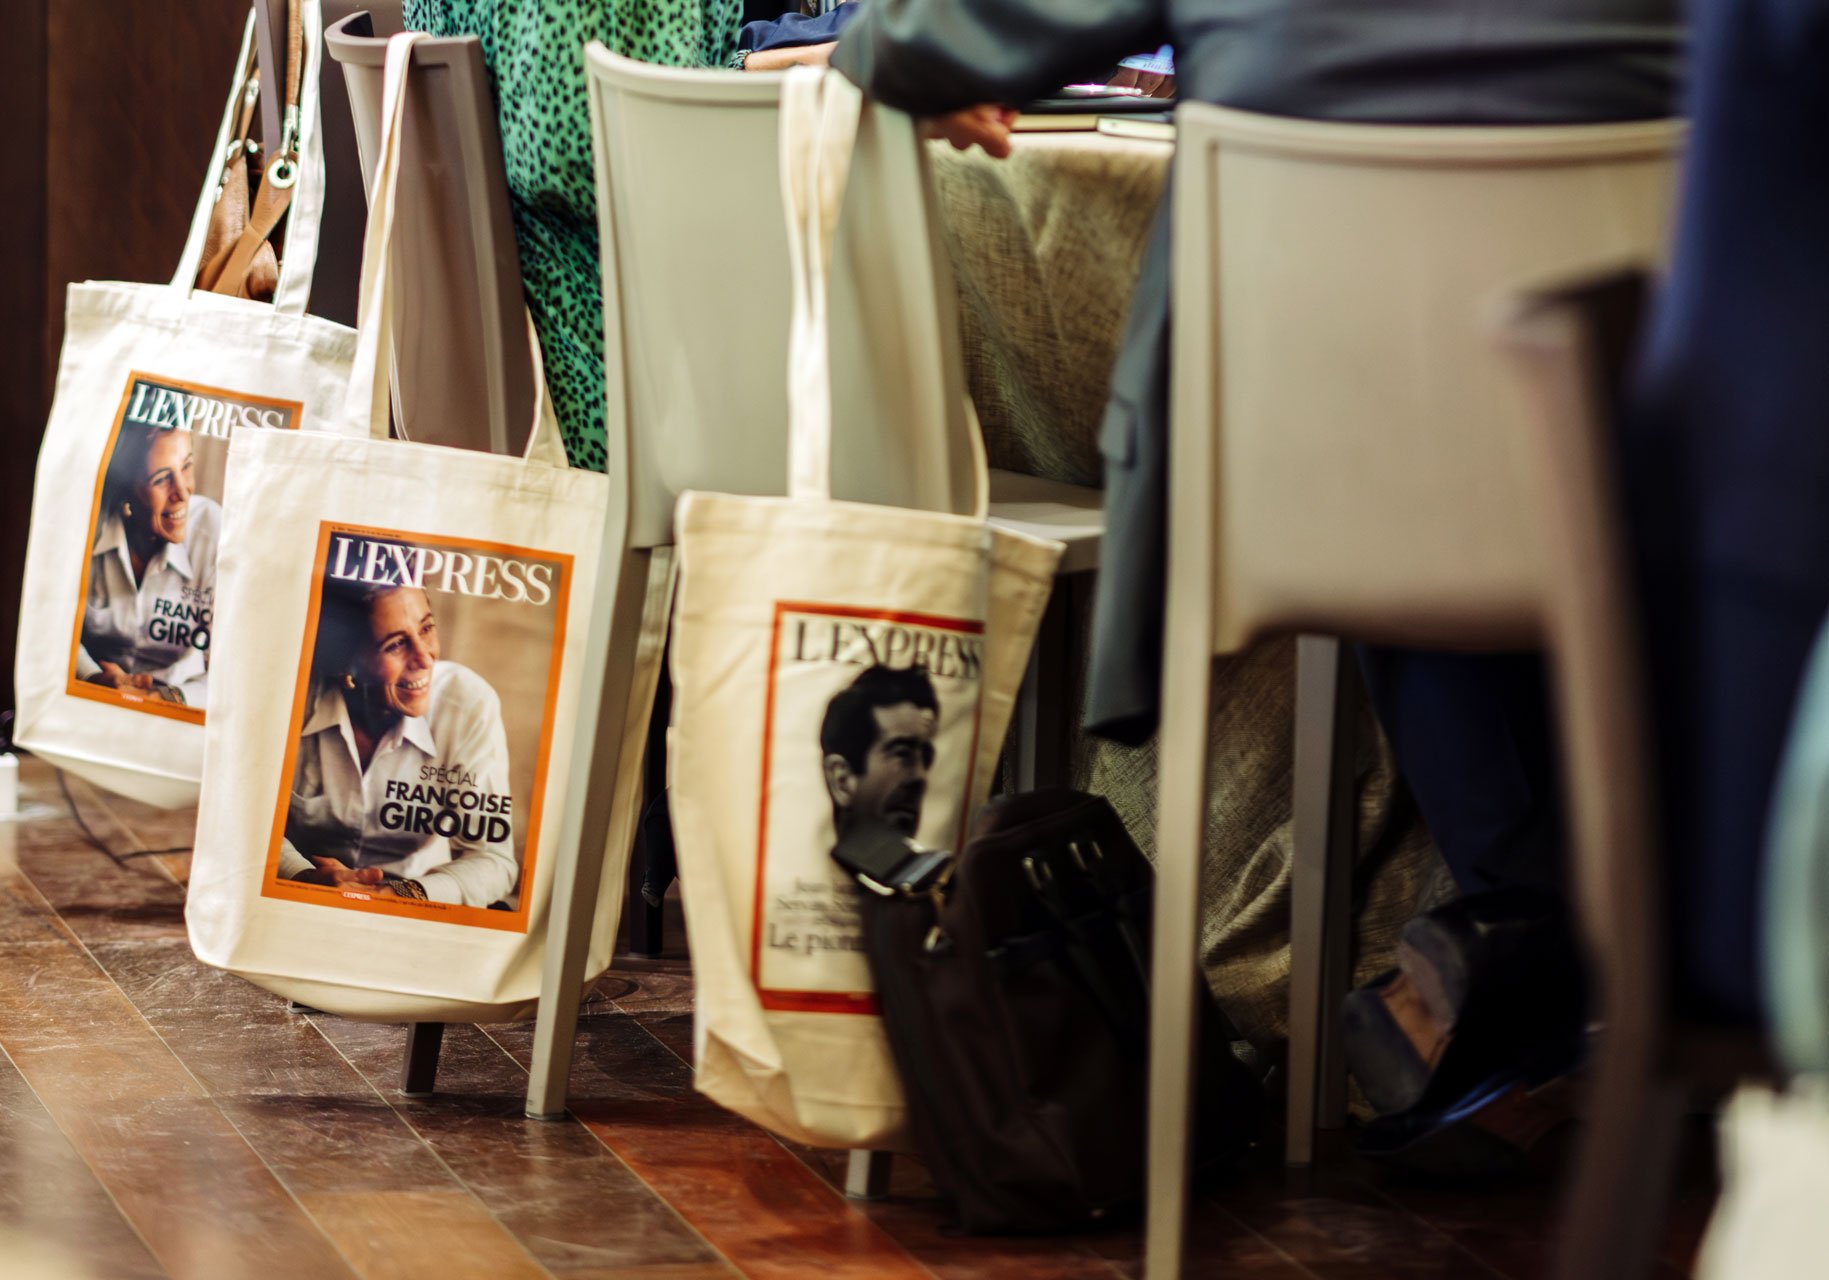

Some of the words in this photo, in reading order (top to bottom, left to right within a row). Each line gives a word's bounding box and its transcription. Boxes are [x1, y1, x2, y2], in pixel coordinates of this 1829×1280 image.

[330, 536, 552, 606] L'EXPRESS
[149, 616, 210, 651] GIRO
[379, 802, 511, 843] GIROUD
